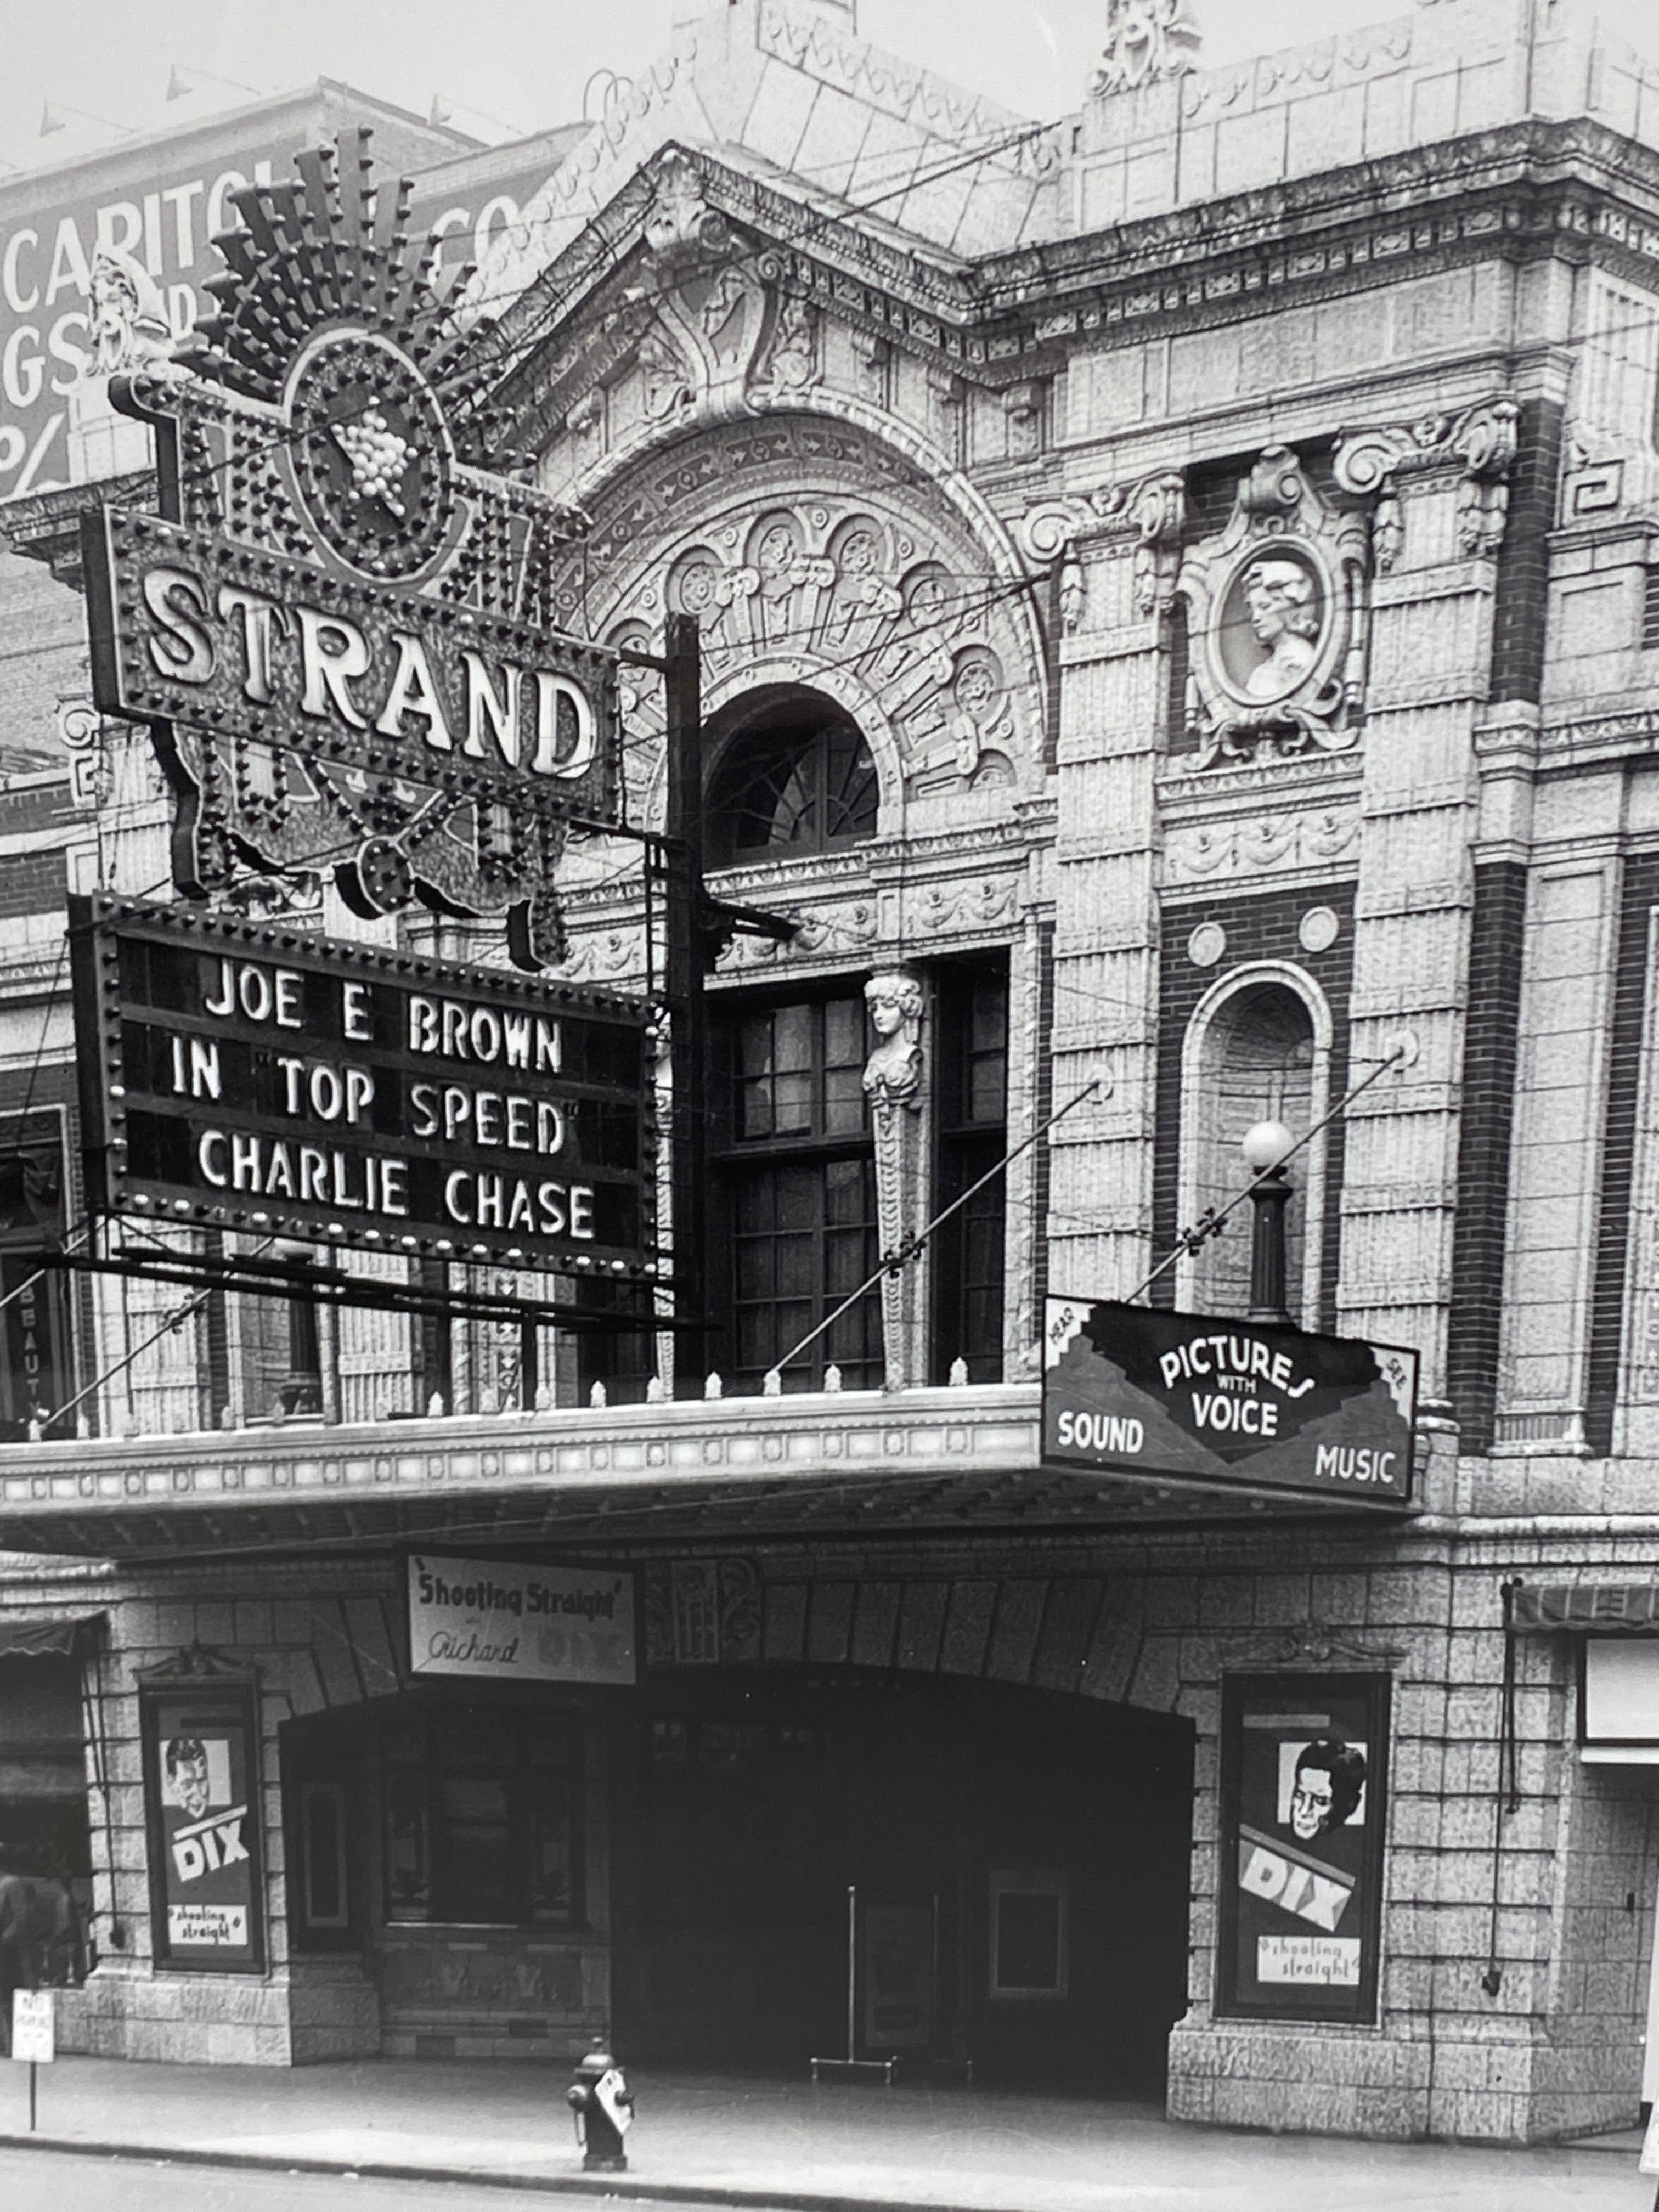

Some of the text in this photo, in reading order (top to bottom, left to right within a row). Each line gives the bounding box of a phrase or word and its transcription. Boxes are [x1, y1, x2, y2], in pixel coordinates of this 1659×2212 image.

[144, 566, 597, 780] STRAND
[205, 958, 562, 1074] JOE E BROWN
[172, 1036, 222, 1098] IN
[199, 1130, 595, 1239] CHARLIE CHASE
[1158, 1335, 1316, 1398] PICTURES
[1216, 1373, 1258, 1395] WITH
[1058, 1410, 1144, 1454] SOUND
[1192, 1392, 1279, 1437] VOICE
[1315, 1443, 1397, 1484] MUSIC
[172, 1819, 250, 1883] DIX
[1239, 1846, 1352, 1932] DIX
